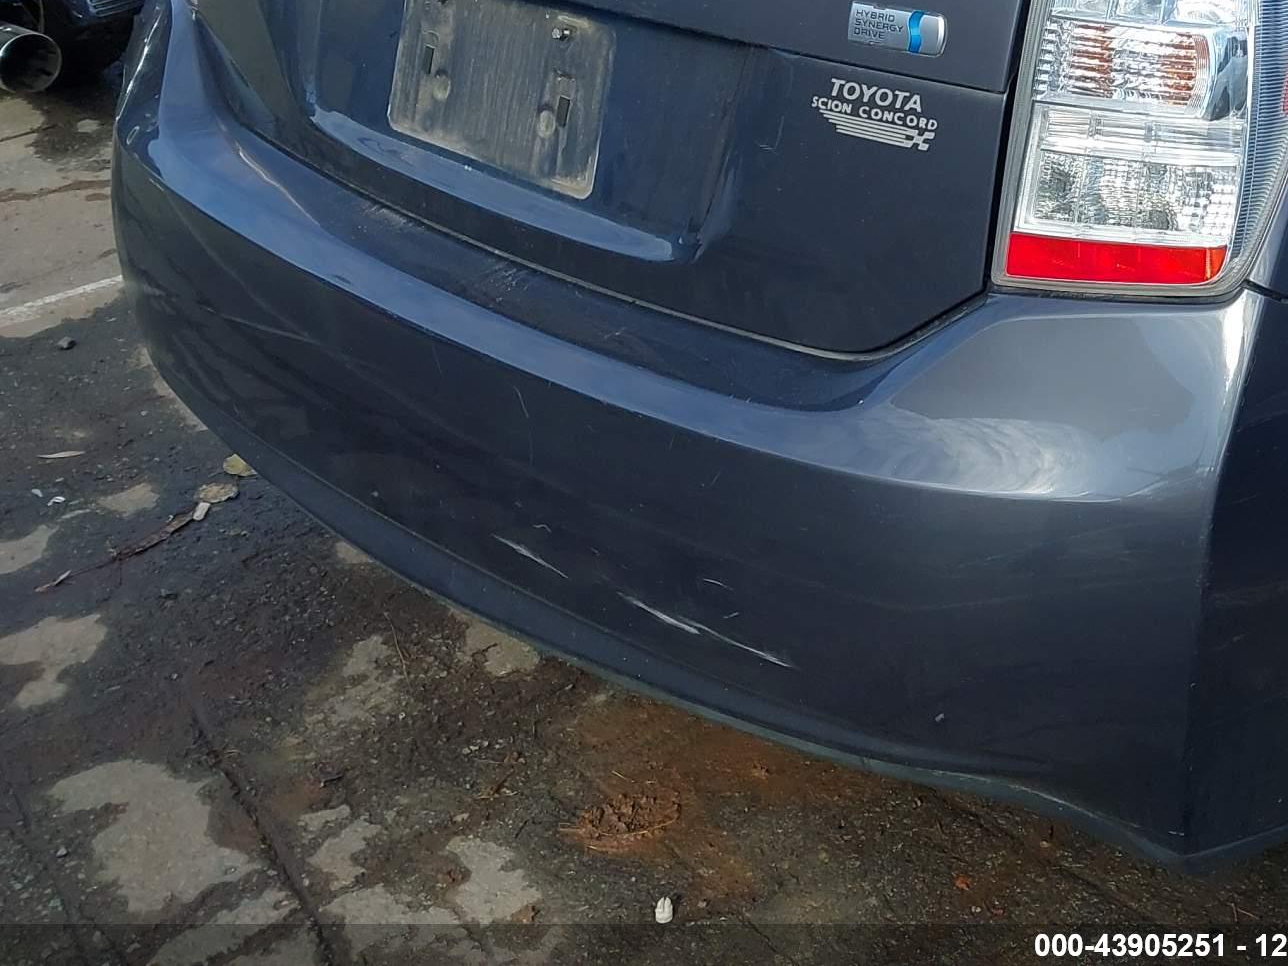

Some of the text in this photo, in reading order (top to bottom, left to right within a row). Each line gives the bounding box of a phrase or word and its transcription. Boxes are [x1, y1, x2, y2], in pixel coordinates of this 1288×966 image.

[855, 9, 896, 23] HYBRID
[854, 18, 904, 33] SYNERGY
[853, 27, 886, 40] DRIVE
[830, 77, 922, 113] TOYOTA
[811, 95, 938, 131] SCION CONCORD
